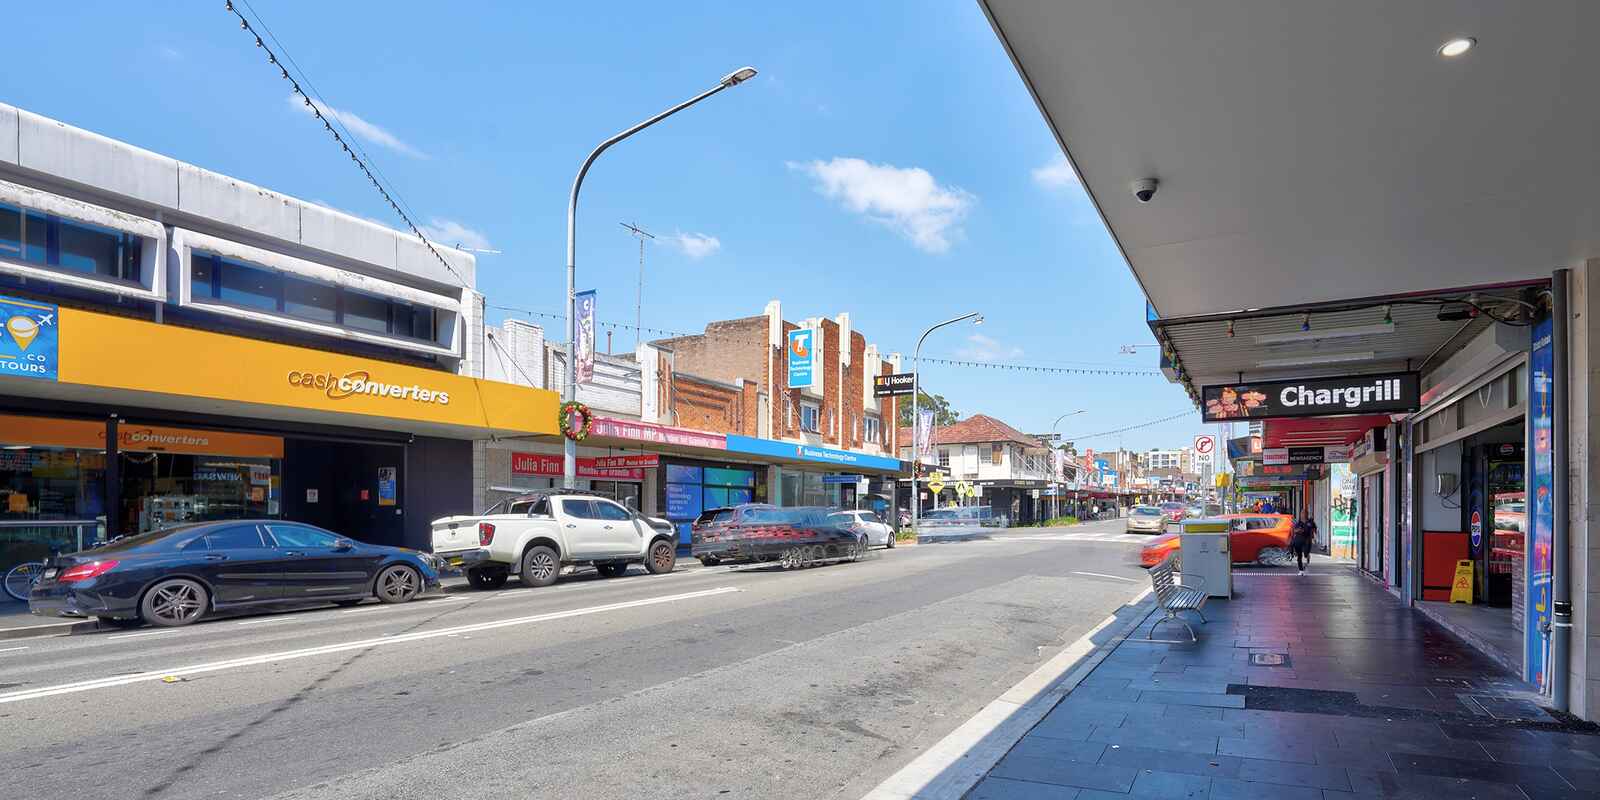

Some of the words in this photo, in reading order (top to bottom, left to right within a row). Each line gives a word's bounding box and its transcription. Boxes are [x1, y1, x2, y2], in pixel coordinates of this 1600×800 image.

[0, 361, 47, 373] TOURS
[891, 376, 914, 385] Hooker
[1280, 379, 1401, 408] Chargrill
[514, 458, 537, 471] Julia
[541, 459, 560, 473] Finn
